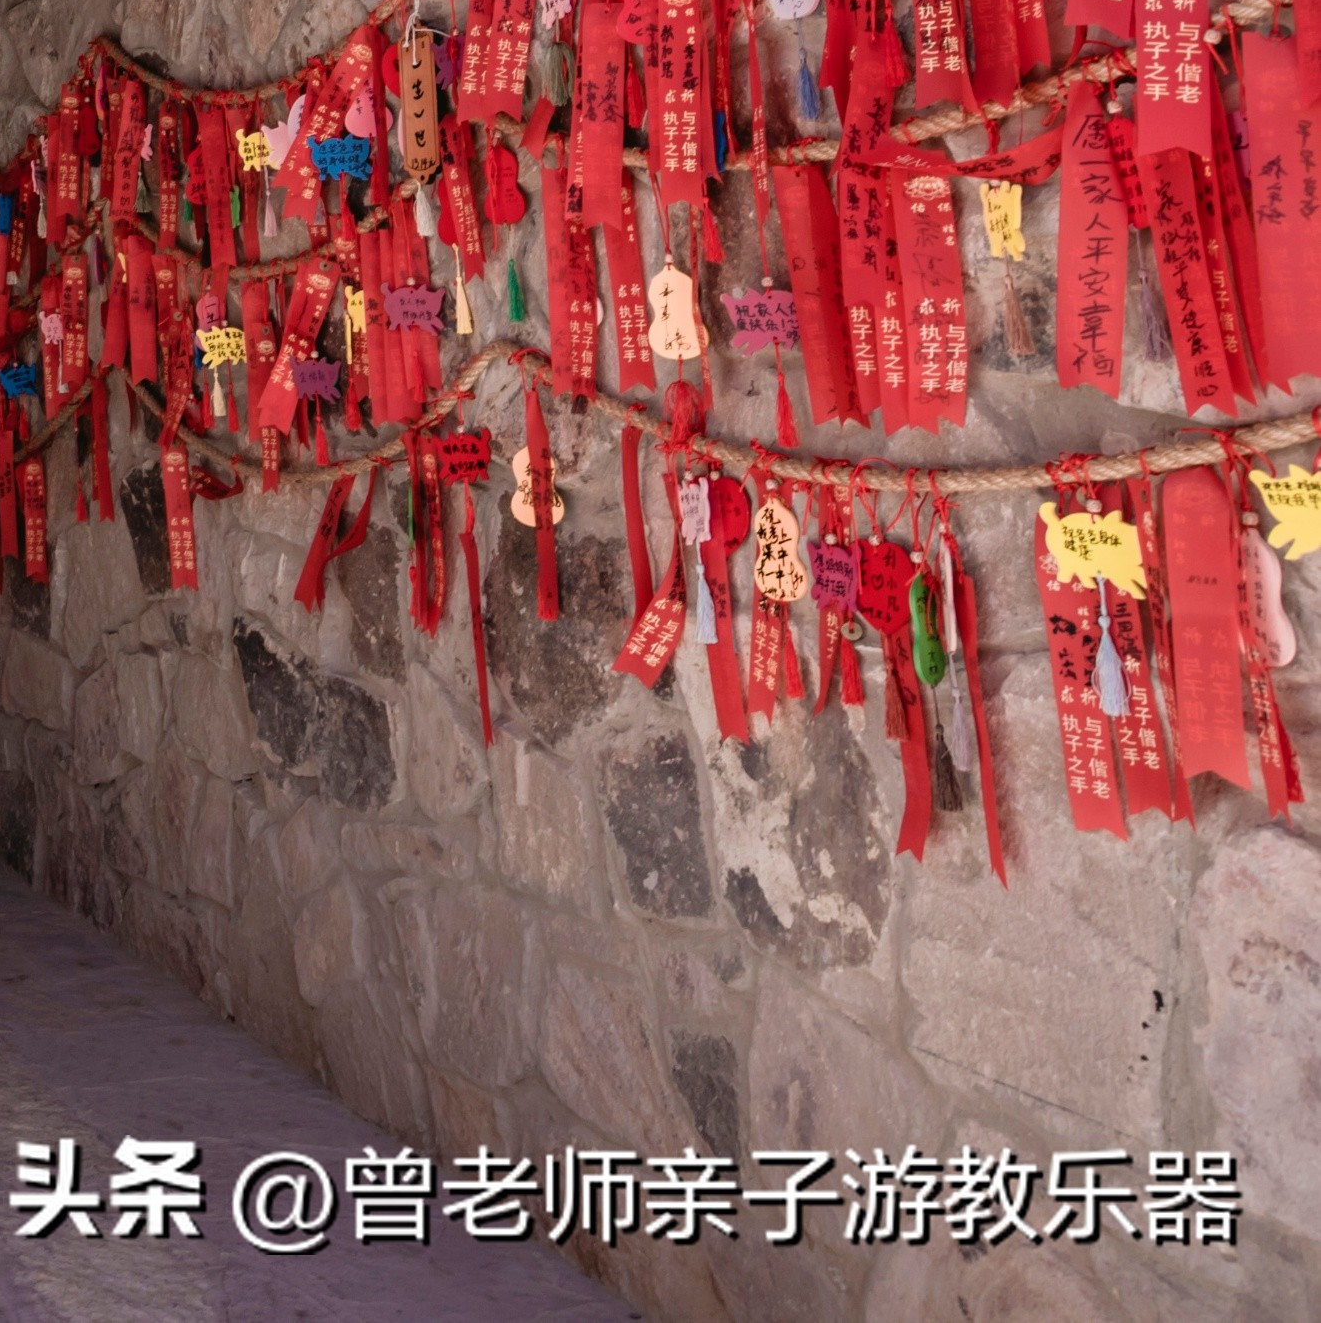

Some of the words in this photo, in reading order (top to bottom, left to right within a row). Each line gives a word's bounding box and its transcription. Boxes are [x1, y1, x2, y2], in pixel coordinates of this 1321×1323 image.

[491, 38, 512, 93] 执子之手
[509, 40, 530, 95] 与子偕老
[918, 3, 941, 74] 执子之手
[938, 0, 961, 72] 与子偕老
[1143, 20, 1171, 101] 执子之手
[1175, 21, 1203, 104] 与子偕老
[461, 43, 482, 95] 执子之手
[662, 110, 681, 173] 执子之手
[681, 110, 698, 173] 与子偕老
[581, 321, 594, 378] 与子偕老
[618, 304, 637, 363] 执子之手
[633, 304, 651, 363] 与子偕老
[850, 305, 877, 376] 执子之手
[881, 316, 906, 389] 执子之手
[919, 323, 943, 392] 执子之手
[945, 323, 968, 393] 与子偕老
[170, 530, 183, 572] 执子之手
[181, 529, 196, 572] 与子偕老
[627, 611, 661, 658] 执子之手
[642, 618, 679, 667] 与子偕老
[753, 619, 767, 682] 执子之手
[764, 626, 781, 691] 与子偕老
[1061, 714, 1089, 794] 执子之手
[1085, 716, 1111, 799] 与子偕老
[1131, 685, 1162, 770] 与子偕老
